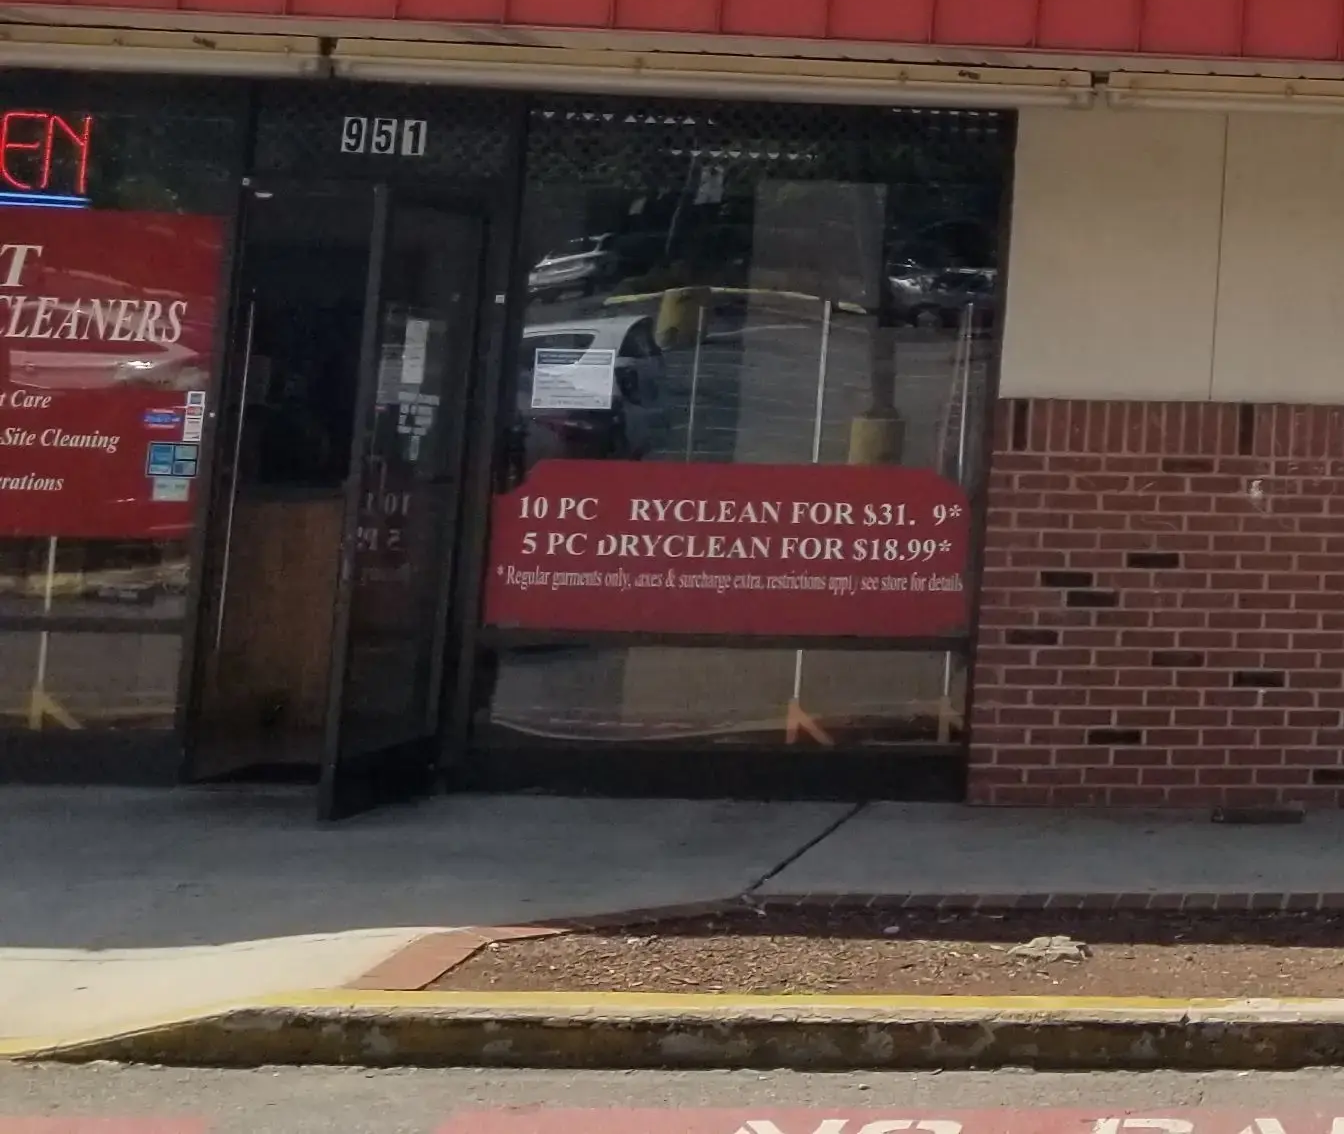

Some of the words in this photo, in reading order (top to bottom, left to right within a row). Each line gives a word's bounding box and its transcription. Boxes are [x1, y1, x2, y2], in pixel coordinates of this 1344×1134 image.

[343, 117, 424, 154] 951
[11, 389, 52, 408] Care
[41, 428, 120, 454] Cleaning
[0, 472, 64, 491] rations
[519, 496, 548, 519] 10
[557, 497, 599, 520] PC
[791, 502, 854, 525] FOR
[521, 532, 537, 555] 5
[546, 532, 588, 556] PC
[596, 534, 773, 559] DRYCLEAN
[780, 537, 845, 560] FOR
[552, 570, 602, 591] garments
[665, 568, 676, 588] &
[678, 570, 732, 594] surcharge
[767, 571, 827, 591] restrictions
[860, 576, 879, 591] see
[881, 575, 908, 591] store
[910, 572, 928, 592] for
[929, 573, 963, 592] details
